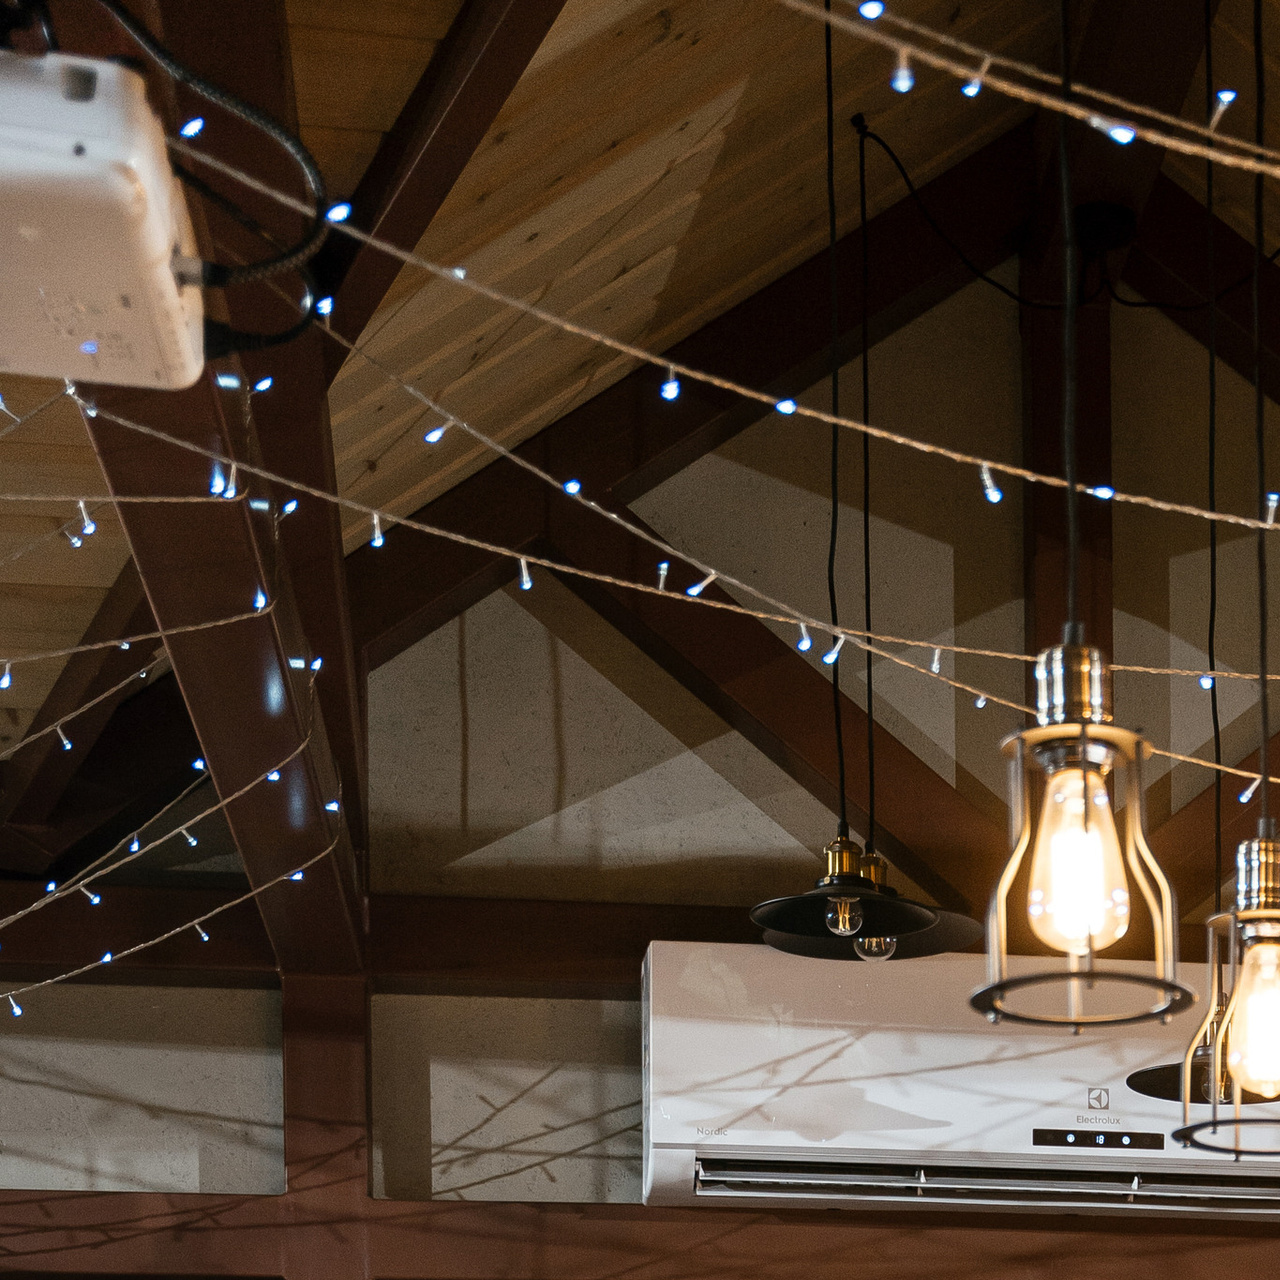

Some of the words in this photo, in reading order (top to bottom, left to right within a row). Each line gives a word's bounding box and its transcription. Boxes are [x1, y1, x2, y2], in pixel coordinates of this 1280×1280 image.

[1076, 1115, 1121, 1124] Electrolux
[697, 1127, 728, 1136] Nordic
[1096, 1134, 1105, 1144] 18
